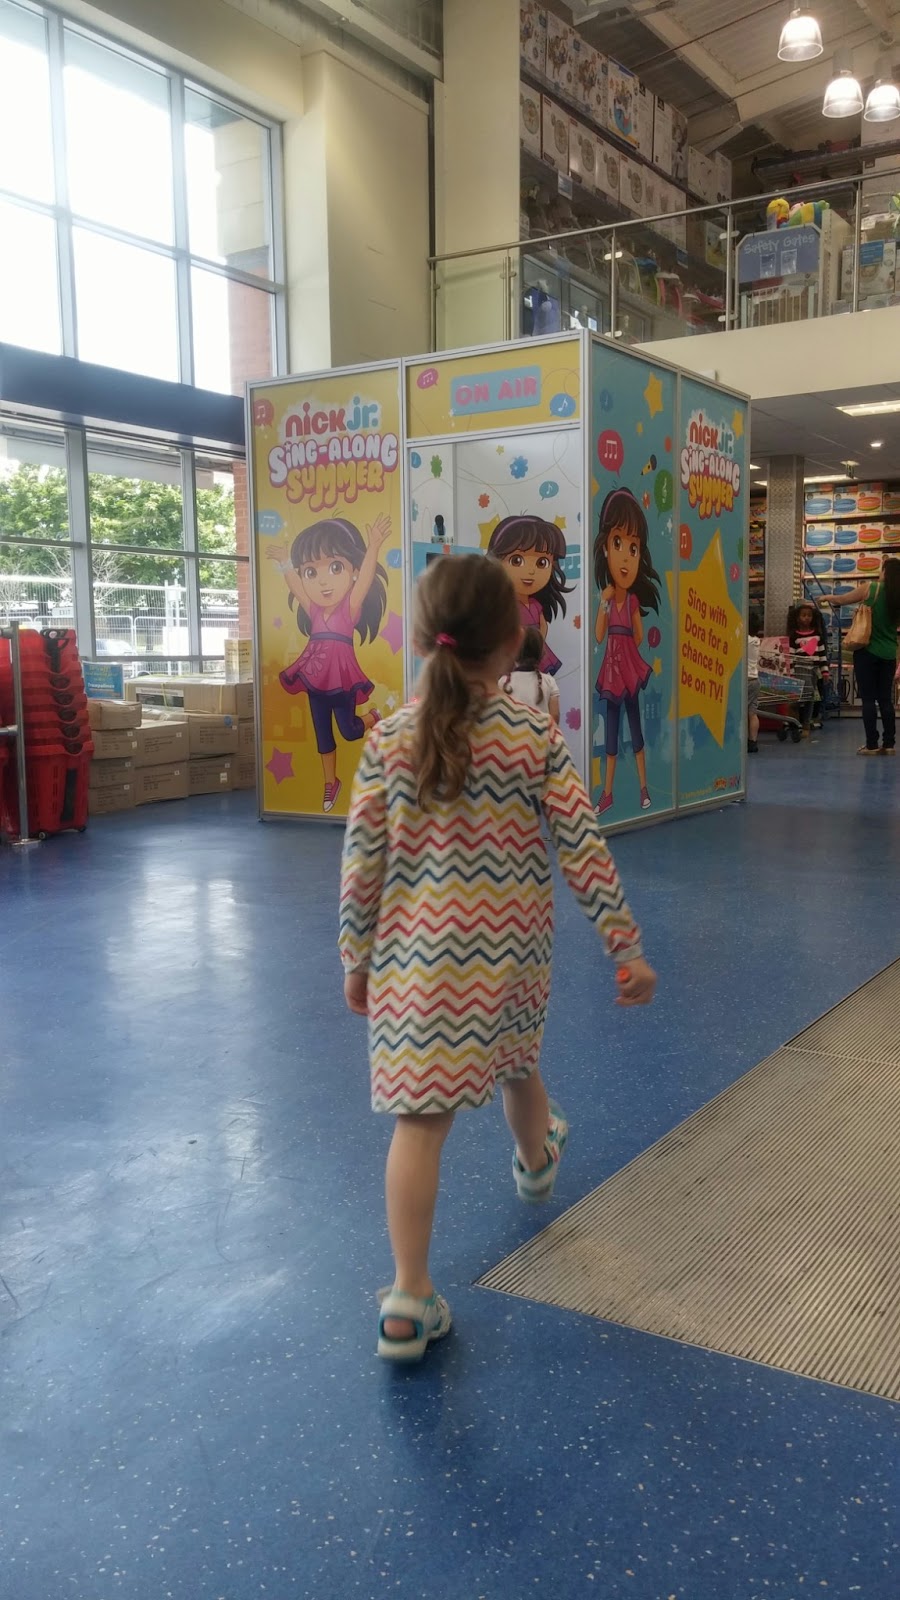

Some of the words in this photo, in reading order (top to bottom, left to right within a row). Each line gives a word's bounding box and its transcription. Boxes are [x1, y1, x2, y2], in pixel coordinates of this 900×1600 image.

[744, 239, 779, 255] Safety
[783, 234, 815, 247] Gates
[455, 381, 490, 406] ON
[497, 375, 538, 400] AIR
[285, 401, 347, 437] nick
[346, 395, 380, 432] jr.
[689, 413, 718, 449] nick
[718, 423, 733, 454] jr.
[286, 460, 385, 512] SUMMER
[688, 474, 734, 519] SUMMER
[687, 587, 707, 619] Sing
[709, 605, 727, 628] with
[684, 613, 706, 642] Dora
[708, 629, 721, 649] for
[723, 640, 728, 655] a
[681, 641, 713, 671] chance
[715, 658, 724, 677] to
[681, 665, 693, 688] be
[695, 678, 706, 694] on
[709, 679, 723, 704] TV!
